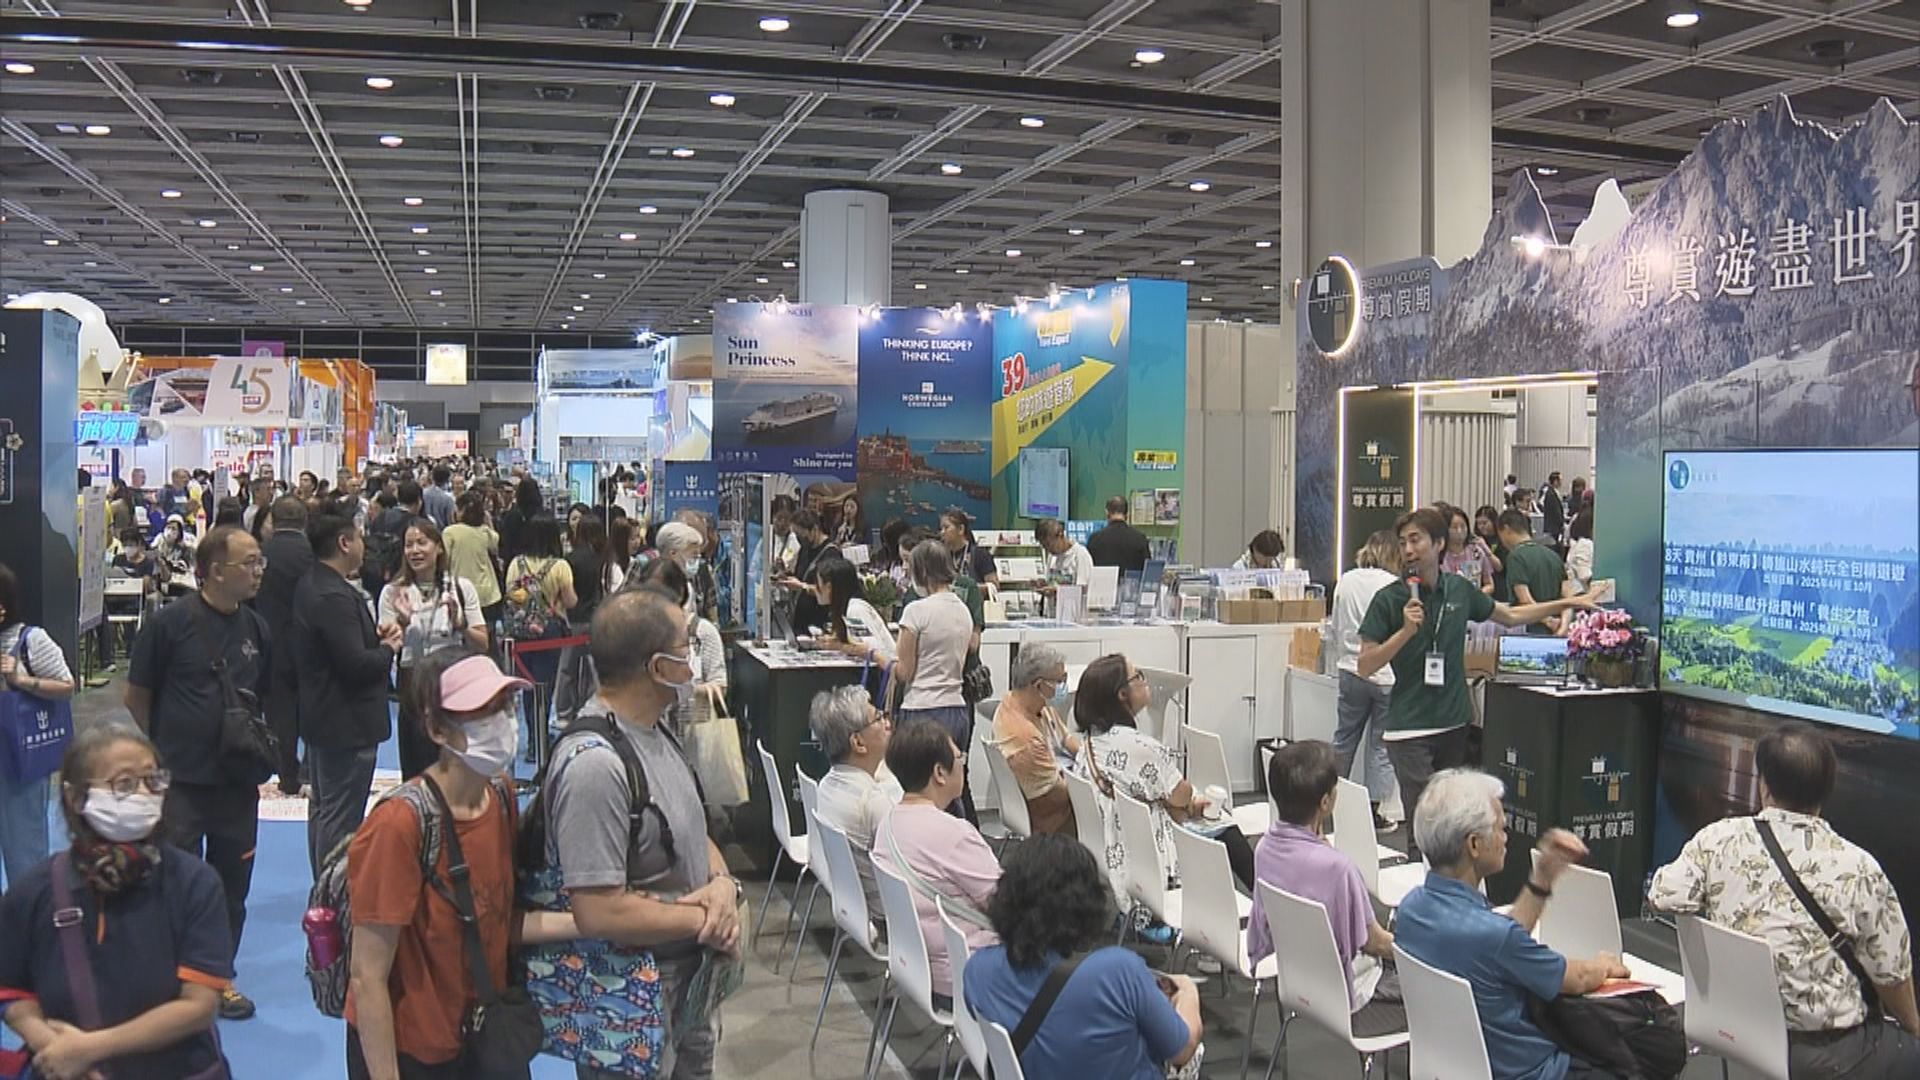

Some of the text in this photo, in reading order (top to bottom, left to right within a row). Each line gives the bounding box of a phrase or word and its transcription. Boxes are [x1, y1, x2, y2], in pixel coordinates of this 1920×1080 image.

[1361, 284, 1431, 321] 尊賞假期
[728, 336, 759, 349] Sun
[883, 338, 973, 351] THINKING EUROPE?
[728, 352, 797, 367] Princess
[902, 351, 954, 362] THINK NCL.
[1002, 353, 1025, 398] 39
[902, 394, 953, 402] NORWEGIAN
[793, 458, 853, 469] Shine for you
[1353, 494, 1404, 508] 尊賞假期
[1665, 548, 1682, 563] 8天
[1664, 588, 1687, 604] 10天
[1573, 819, 1634, 840] 尊賞假期
